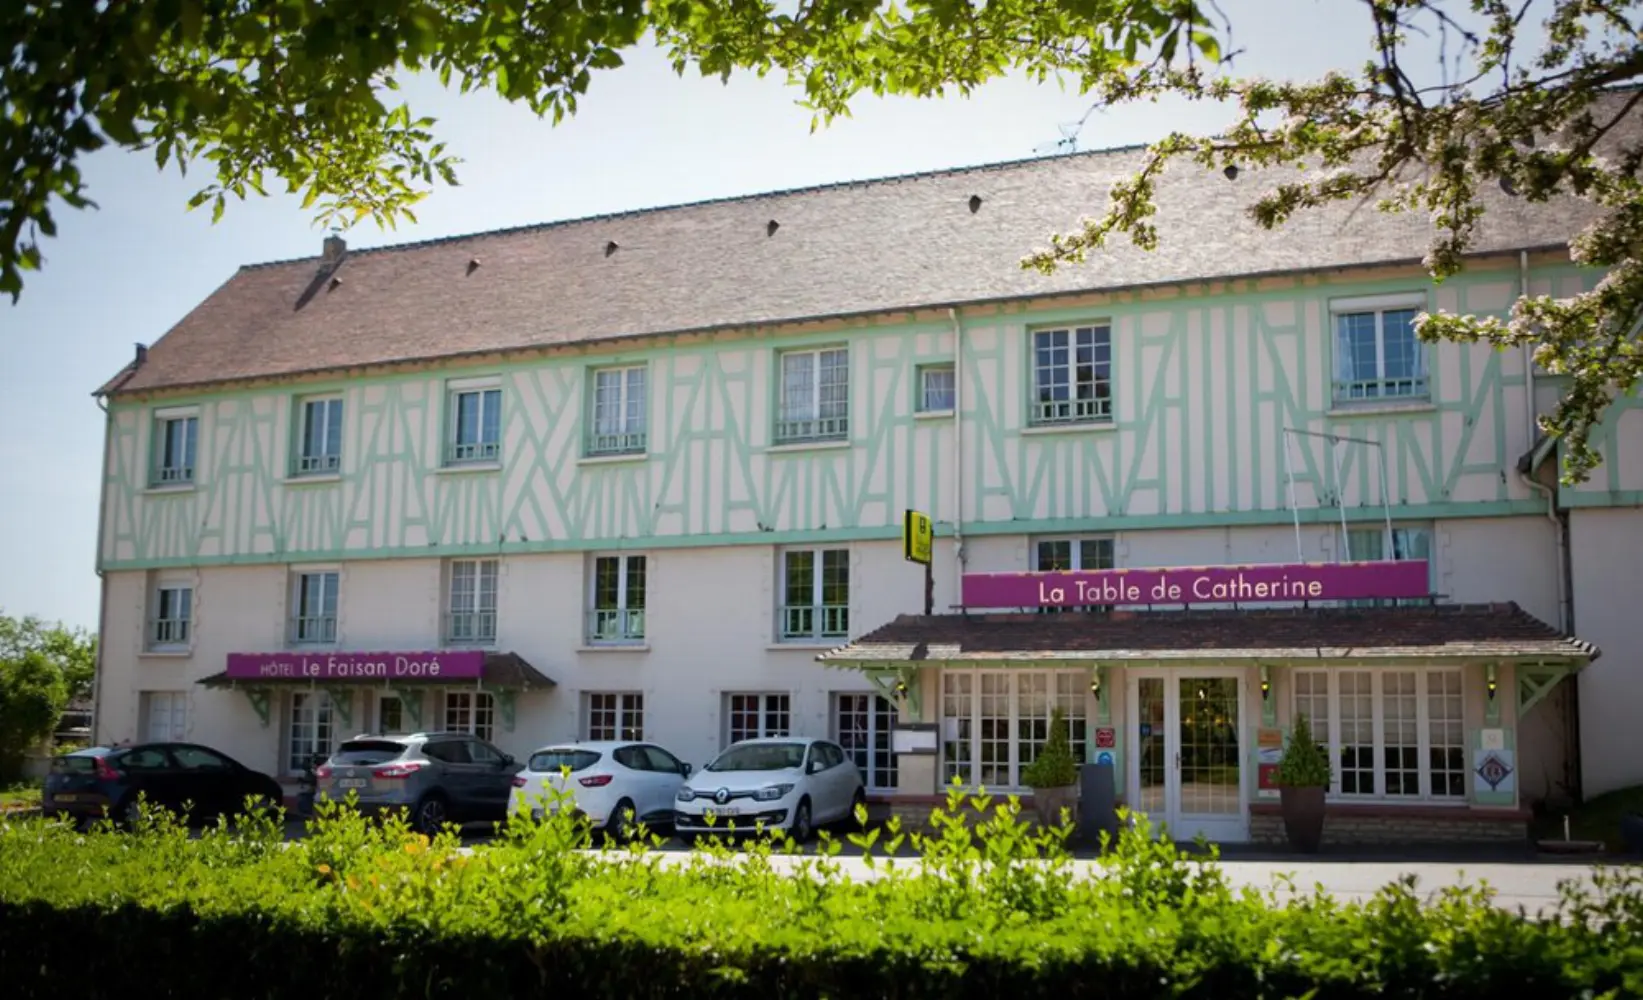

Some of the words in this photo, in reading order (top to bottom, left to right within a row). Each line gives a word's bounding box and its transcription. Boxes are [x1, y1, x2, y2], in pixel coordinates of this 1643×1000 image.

[1039, 581, 1064, 604] La
[1076, 577, 1140, 602] Table
[1151, 577, 1181, 600] de
[1192, 574, 1323, 599] Catherine
[260, 660, 295, 676] HÔTEL
[302, 657, 320, 676] Le
[328, 656, 386, 676] Faisan
[395, 656, 440, 676] Doré
